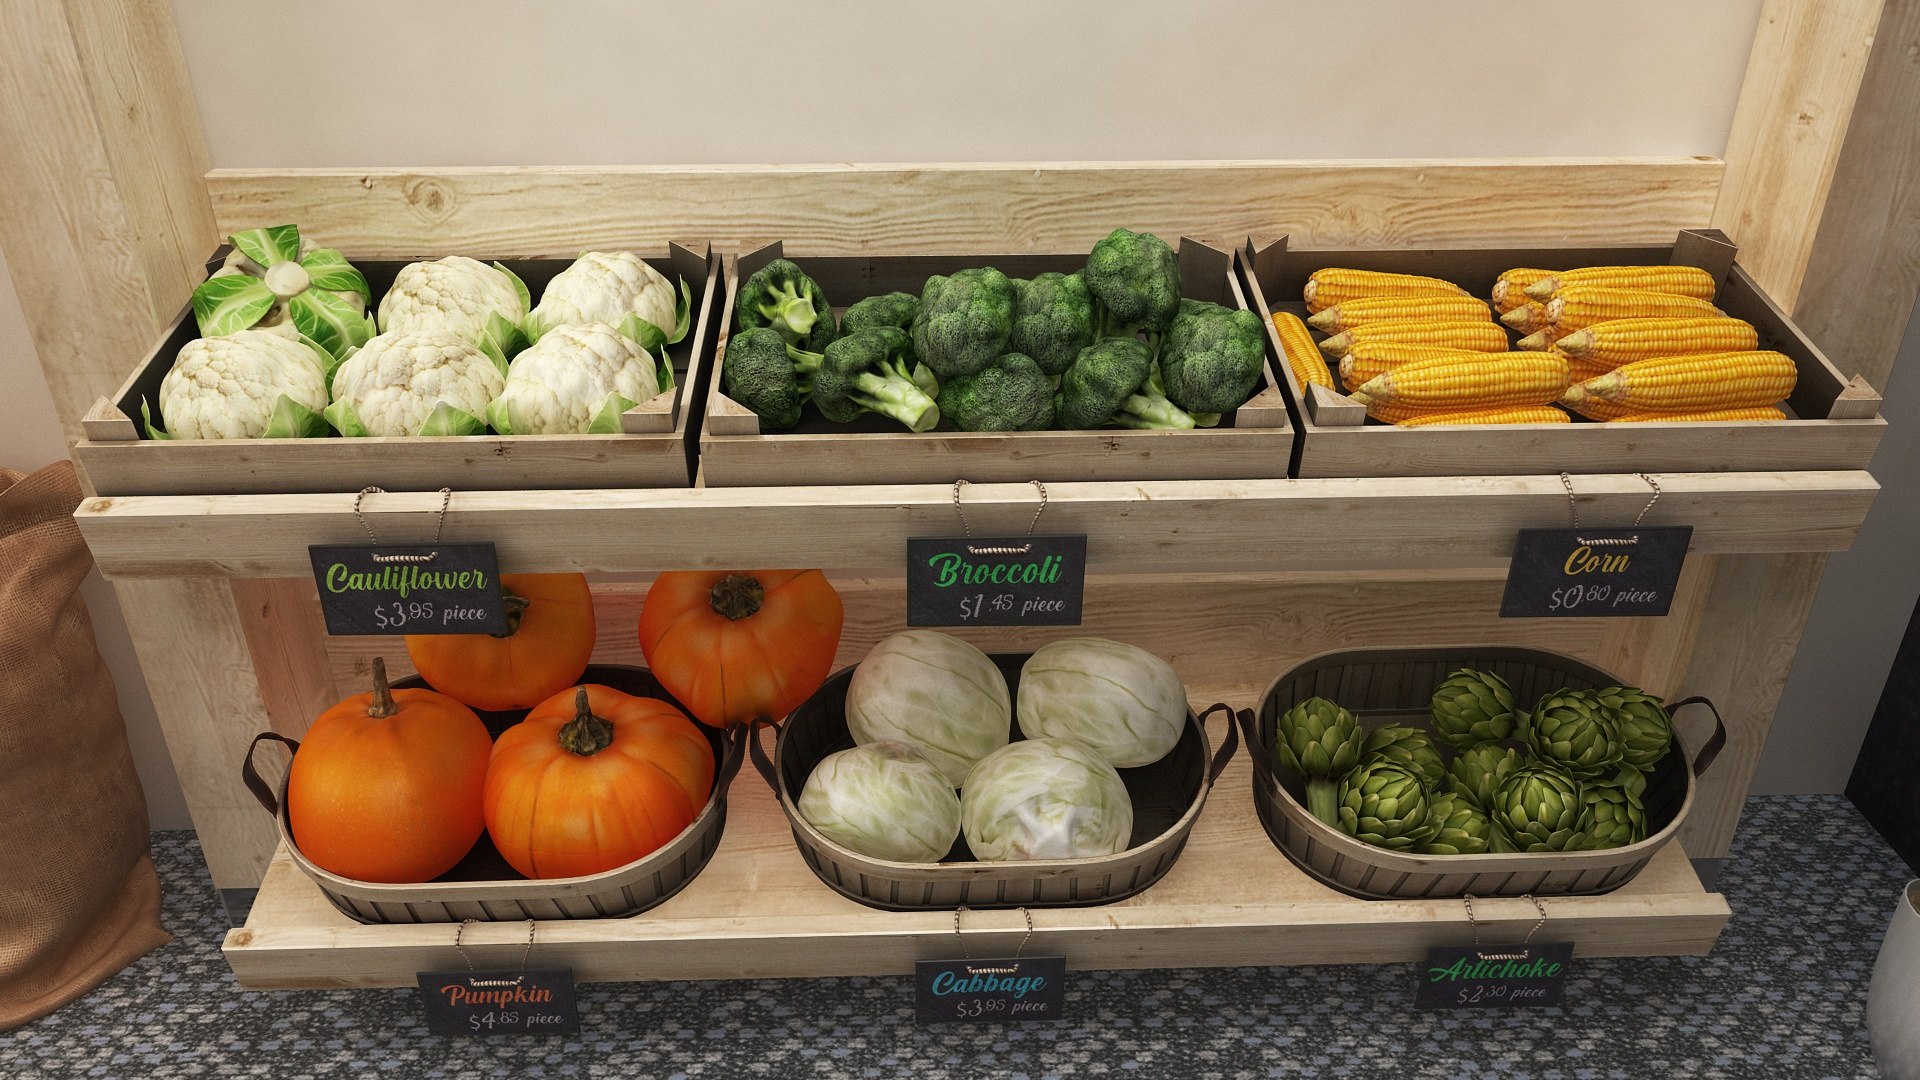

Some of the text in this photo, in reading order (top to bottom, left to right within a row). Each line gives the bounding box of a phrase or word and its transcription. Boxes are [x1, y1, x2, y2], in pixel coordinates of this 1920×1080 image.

[928, 553, 1063, 588] Broccoli
[1564, 545, 1632, 576] Corn
[326, 563, 488, 599] Cauliflower
[1021, 596, 1065, 617] piece
[1549, 584, 1658, 611] $0.80 piece
[374, 602, 487, 630] $3.95 piece
[1428, 957, 1564, 982] Artichoke
[440, 984, 553, 1009] Pumpkin
[932, 971, 1048, 999] Cabbage
[1457, 985, 1546, 1005] $2.30 piece
[469, 1011, 563, 1031] $4.85 piece
[956, 998, 1048, 1019] $3.95 piece
